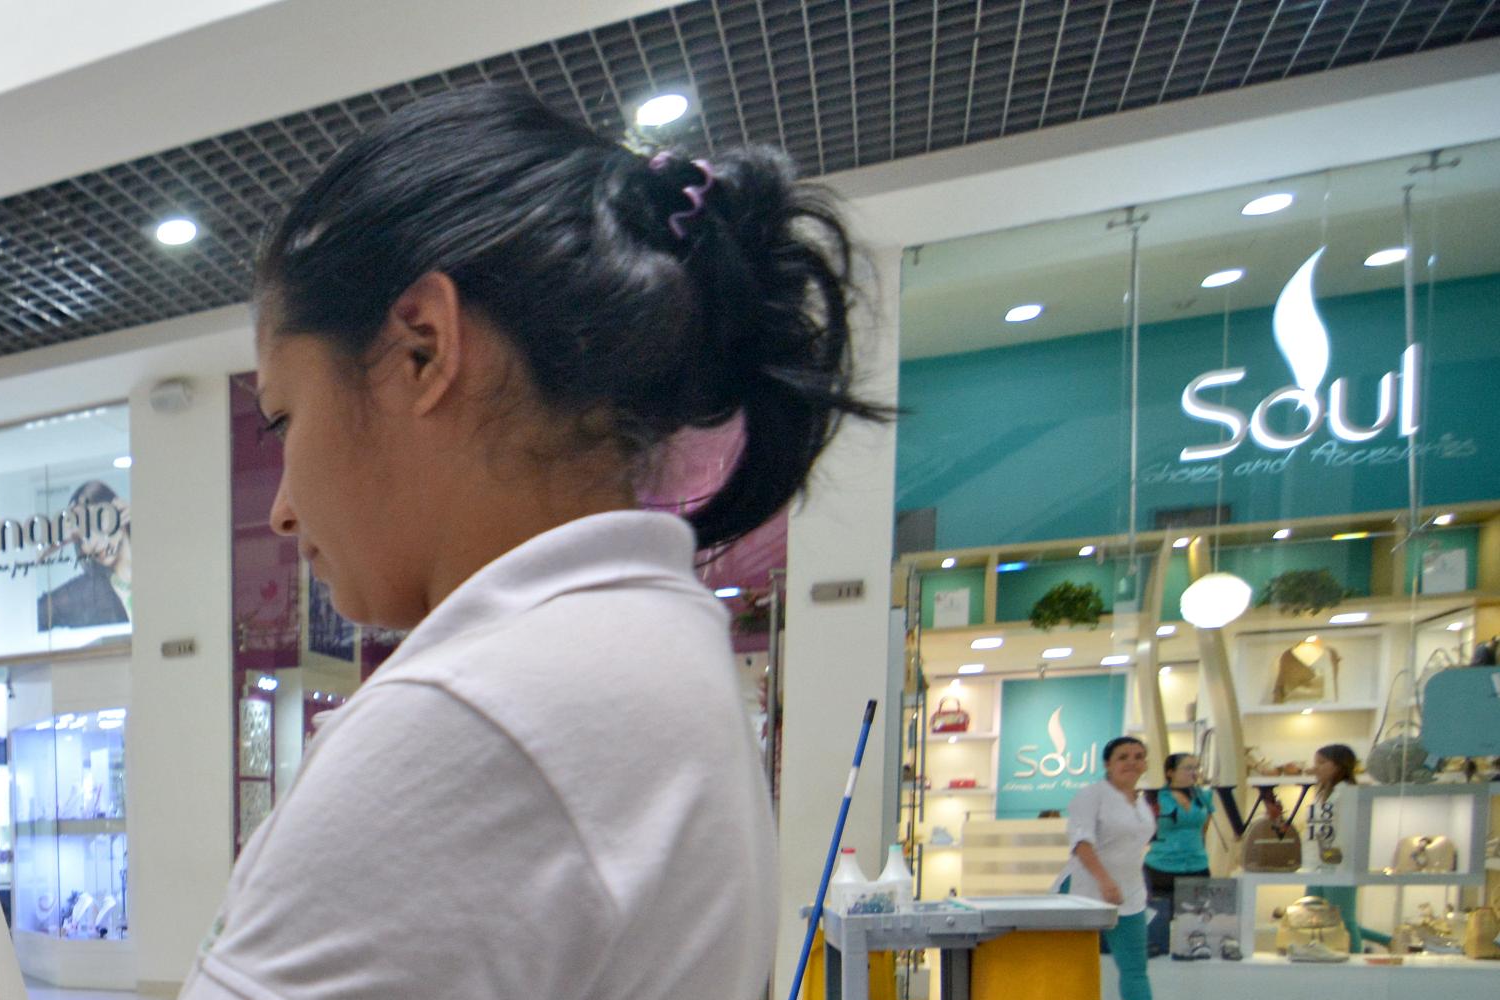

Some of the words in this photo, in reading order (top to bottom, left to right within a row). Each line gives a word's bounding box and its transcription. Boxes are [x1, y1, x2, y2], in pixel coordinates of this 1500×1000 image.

[1180, 341, 1424, 462] Soul
[1233, 446, 1297, 477] and
[1012, 741, 1098, 778] Soul
[1307, 803, 1334, 819] 18
[1307, 823, 1334, 840] 19
